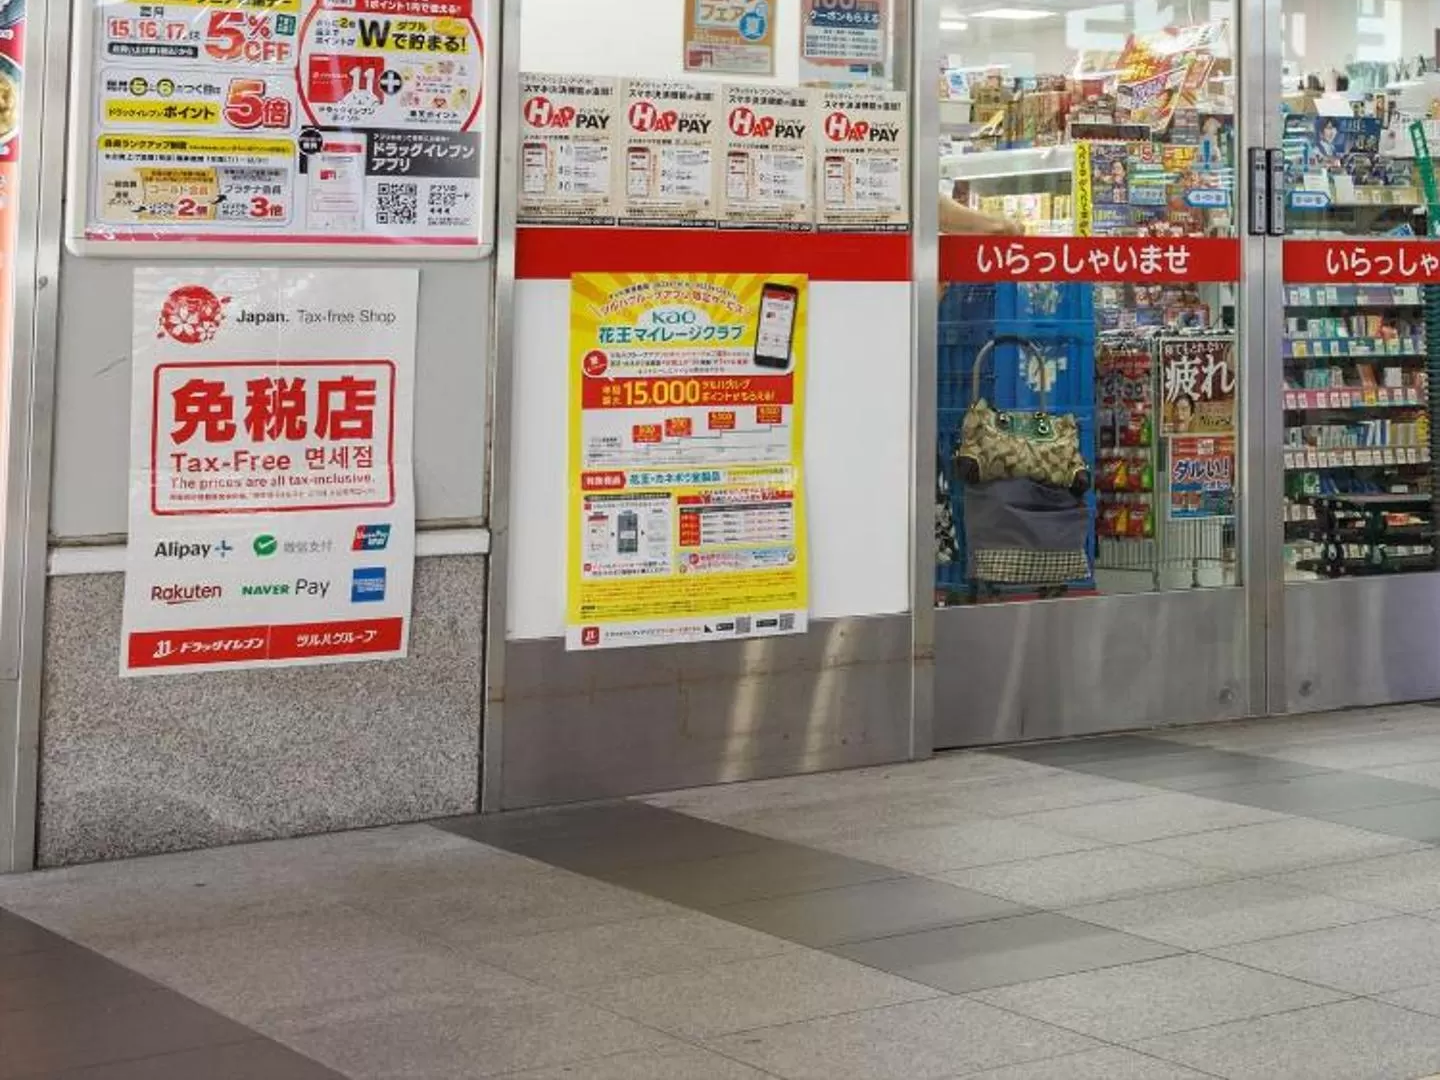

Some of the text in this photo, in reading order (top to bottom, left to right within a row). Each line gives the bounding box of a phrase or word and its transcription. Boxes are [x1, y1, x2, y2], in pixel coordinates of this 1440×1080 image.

[243, 40, 291, 62] OFF
[372, 143, 475, 160] ドラッグイレブン
[371, 158, 411, 172] アプリ
[977, 242, 1191, 276] いらっしゃいませ
[236, 309, 396, 327] Japan. Tax-free Shop
[599, 324, 744, 344] 花王マイレージクラブ
[1164, 354, 1236, 402] 疲れ
[171, 376, 377, 446] 免税店
[171, 446, 373, 473] Tax-Free 면세점
[171, 476, 196, 490] The
[246, 477, 268, 488] are
[270, 476, 286, 487] all
[151, 584, 222, 605] Rakuten
[242, 578, 331, 598] NAVER Pay
[180, 637, 265, 654] ドラッグイレブン
[296, 630, 378, 648] ツルハグループ
